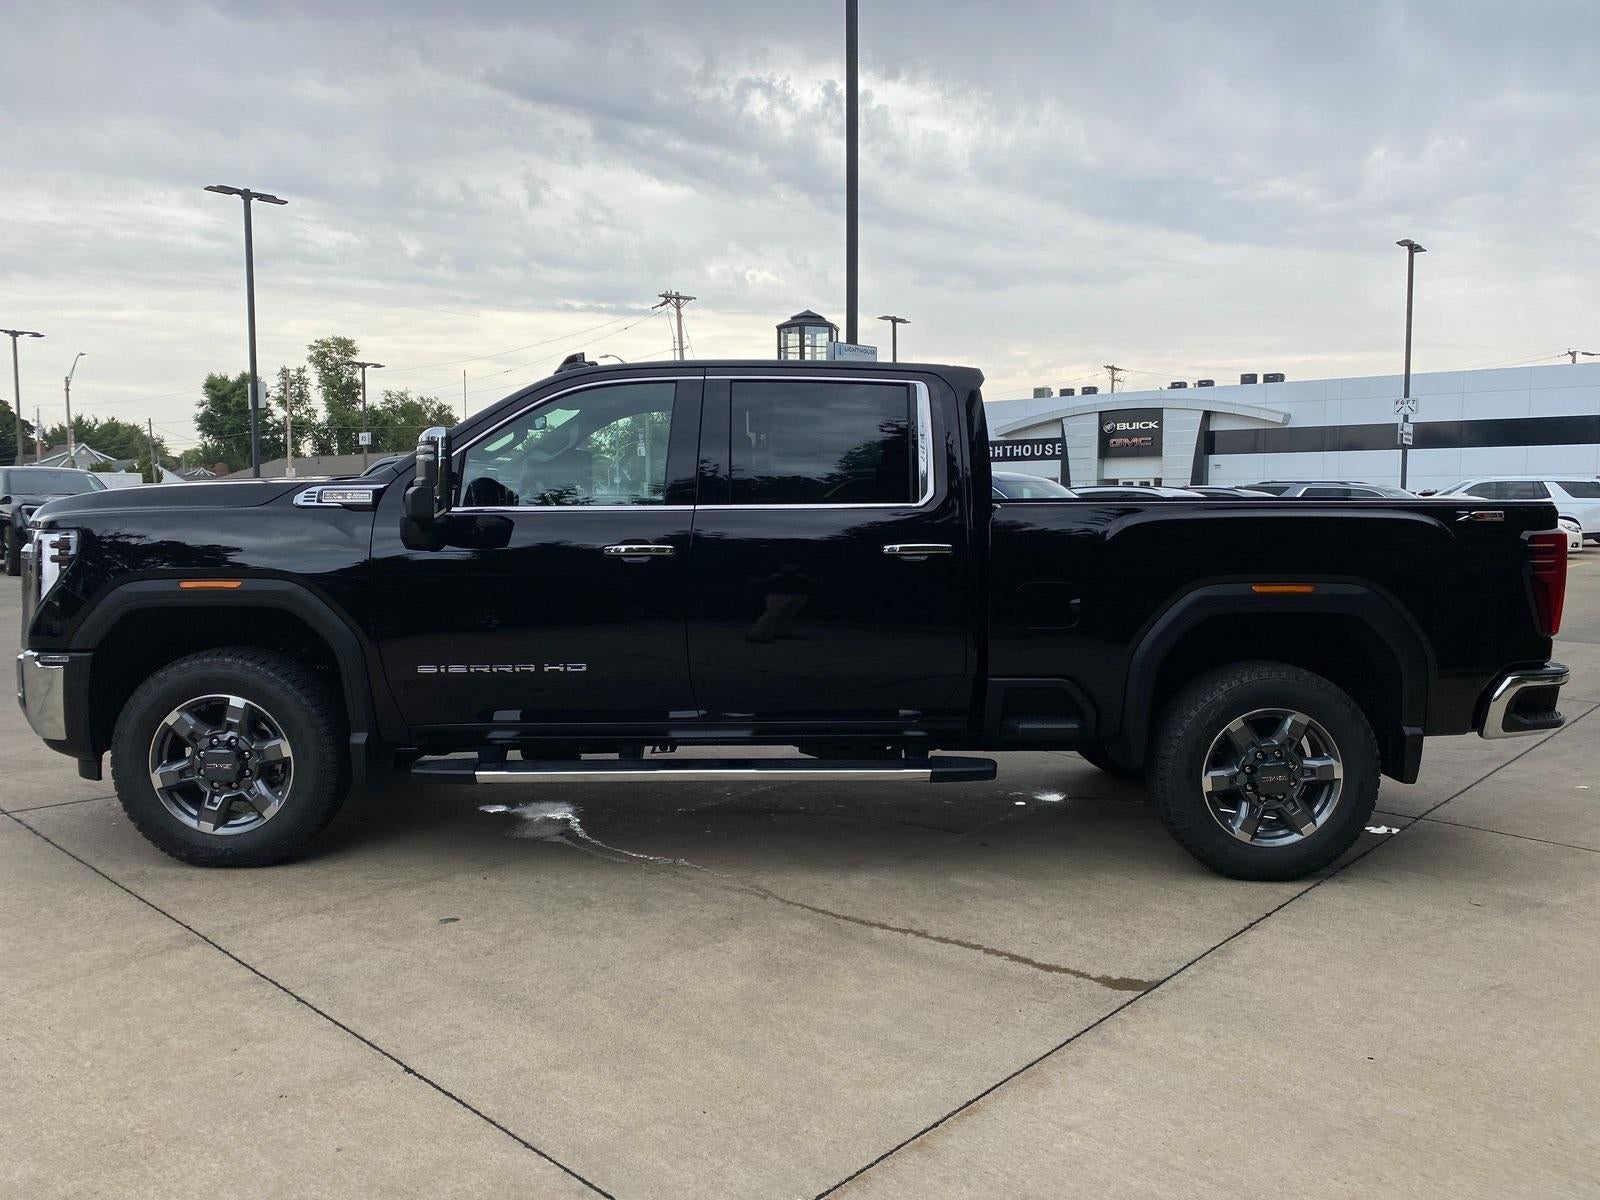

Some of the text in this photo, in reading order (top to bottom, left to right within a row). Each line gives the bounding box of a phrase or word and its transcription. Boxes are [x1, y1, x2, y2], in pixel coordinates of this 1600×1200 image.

[844, 346, 876, 356] LIGHTHOUSE
[1116, 420, 1159, 431] BUICK
[1109, 437, 1152, 447] GMC
[417, 663, 587, 673] SIERRA HD
